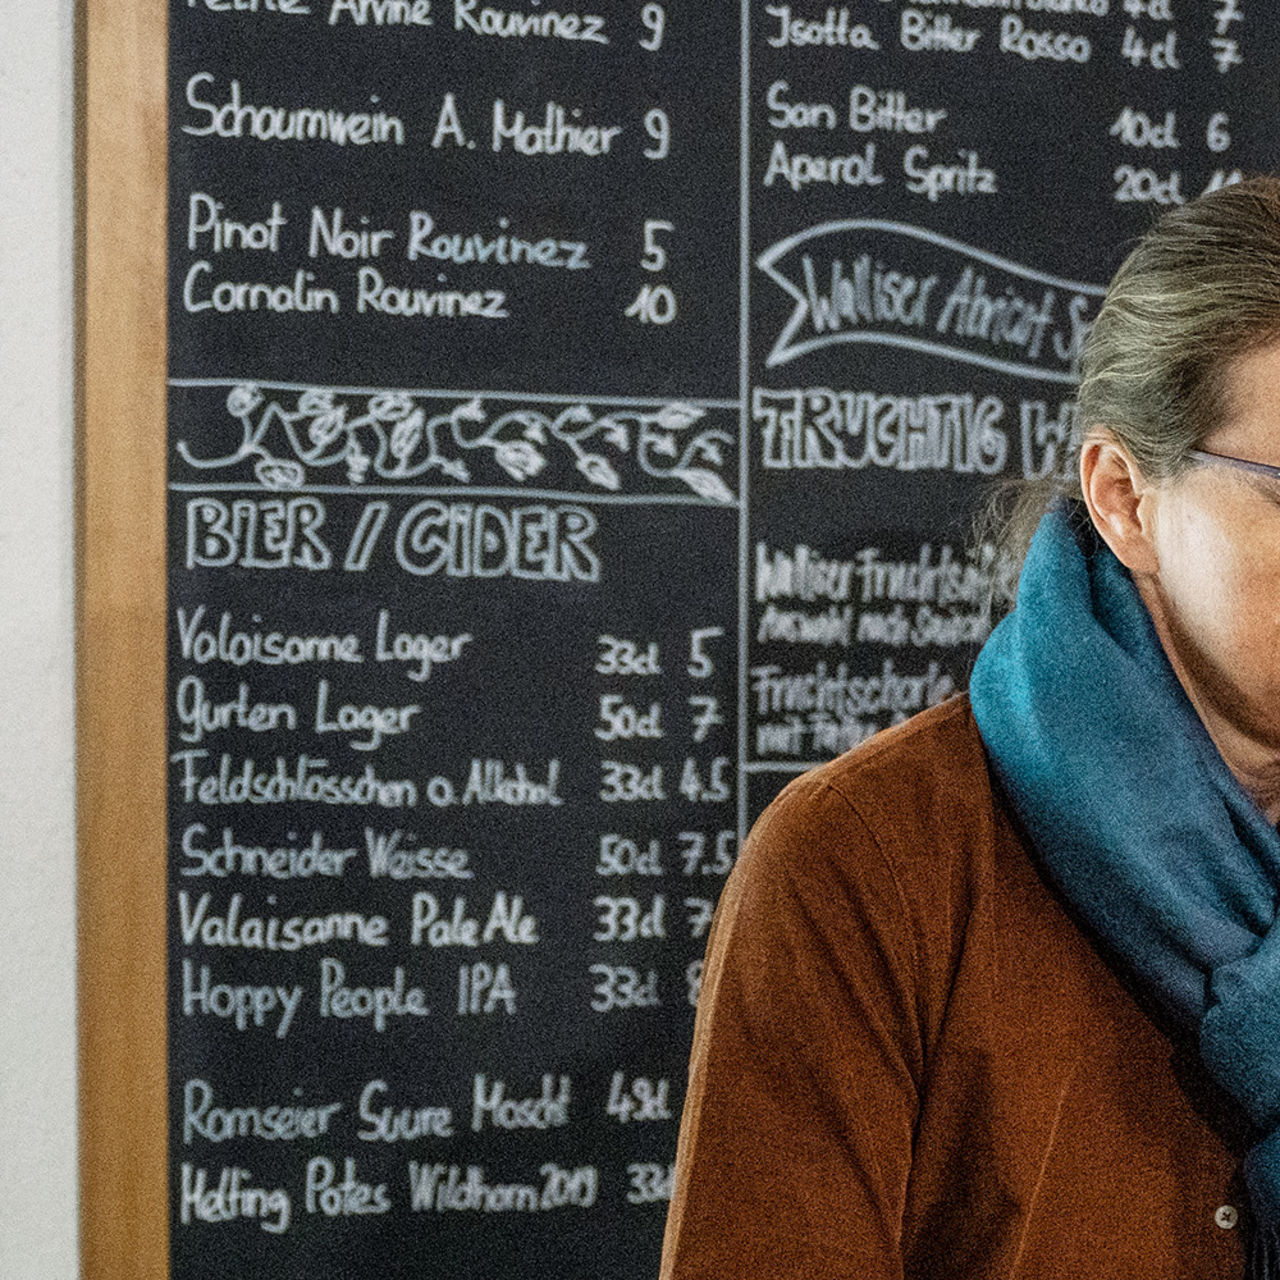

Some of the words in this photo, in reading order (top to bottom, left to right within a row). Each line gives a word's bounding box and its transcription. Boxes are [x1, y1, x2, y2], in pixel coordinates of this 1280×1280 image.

[640, 4, 664, 51] 9
[901, 10, 979, 51] Bitter
[1001, 15, 1090, 62] Rosso
[1212, 39, 1240, 71] 7
[183, 72, 403, 145] Schaumwein
[432, 93, 474, 148] A.
[644, 109, 669, 159] 9
[767, 81, 836, 128] San
[850, 86, 945, 132] Bitter
[1208, 113, 1229, 151] 6
[764, 141, 883, 190] Aperol
[904, 146, 995, 201] Spritz
[188, 192, 285, 252] Pinot
[309, 207, 393, 258] Noir
[408, 211, 589, 269] Rouvinez
[642, 220, 673, 271] 5
[183, 261, 338, 312] Cornalin
[358, 267, 508, 318] Rouvinez
[625, 285, 676, 324] 10
[802, 253, 938, 333] Walliser
[752, 387, 1007, 474] FRUCHTIG
[186, 497, 331, 570] BIER
[345, 502, 389, 570] /
[395, 500, 600, 582] CIDER
[376, 611, 471, 681] Lager
[688, 627, 722, 677] 5
[316, 681, 419, 750] Lager
[690, 697, 719, 740] 7
[681, 758, 728, 800] 4.5
[182, 824, 355, 878] Schneider
[366, 829, 472, 878] Weisse
[680, 832, 733, 873] 7.5
[179, 892, 387, 950] Valaisanne
[412, 892, 477, 946] Pale
[483, 892, 537, 944] Ale
[184, 960, 301, 1036] Hoppy
[321, 959, 428, 1030] People
[459, 963, 515, 1013] IPA
[185, 1080, 339, 1141] Ramseier
[360, 1081, 450, 1141] Suure
[306, 1158, 388, 1215] Potes
